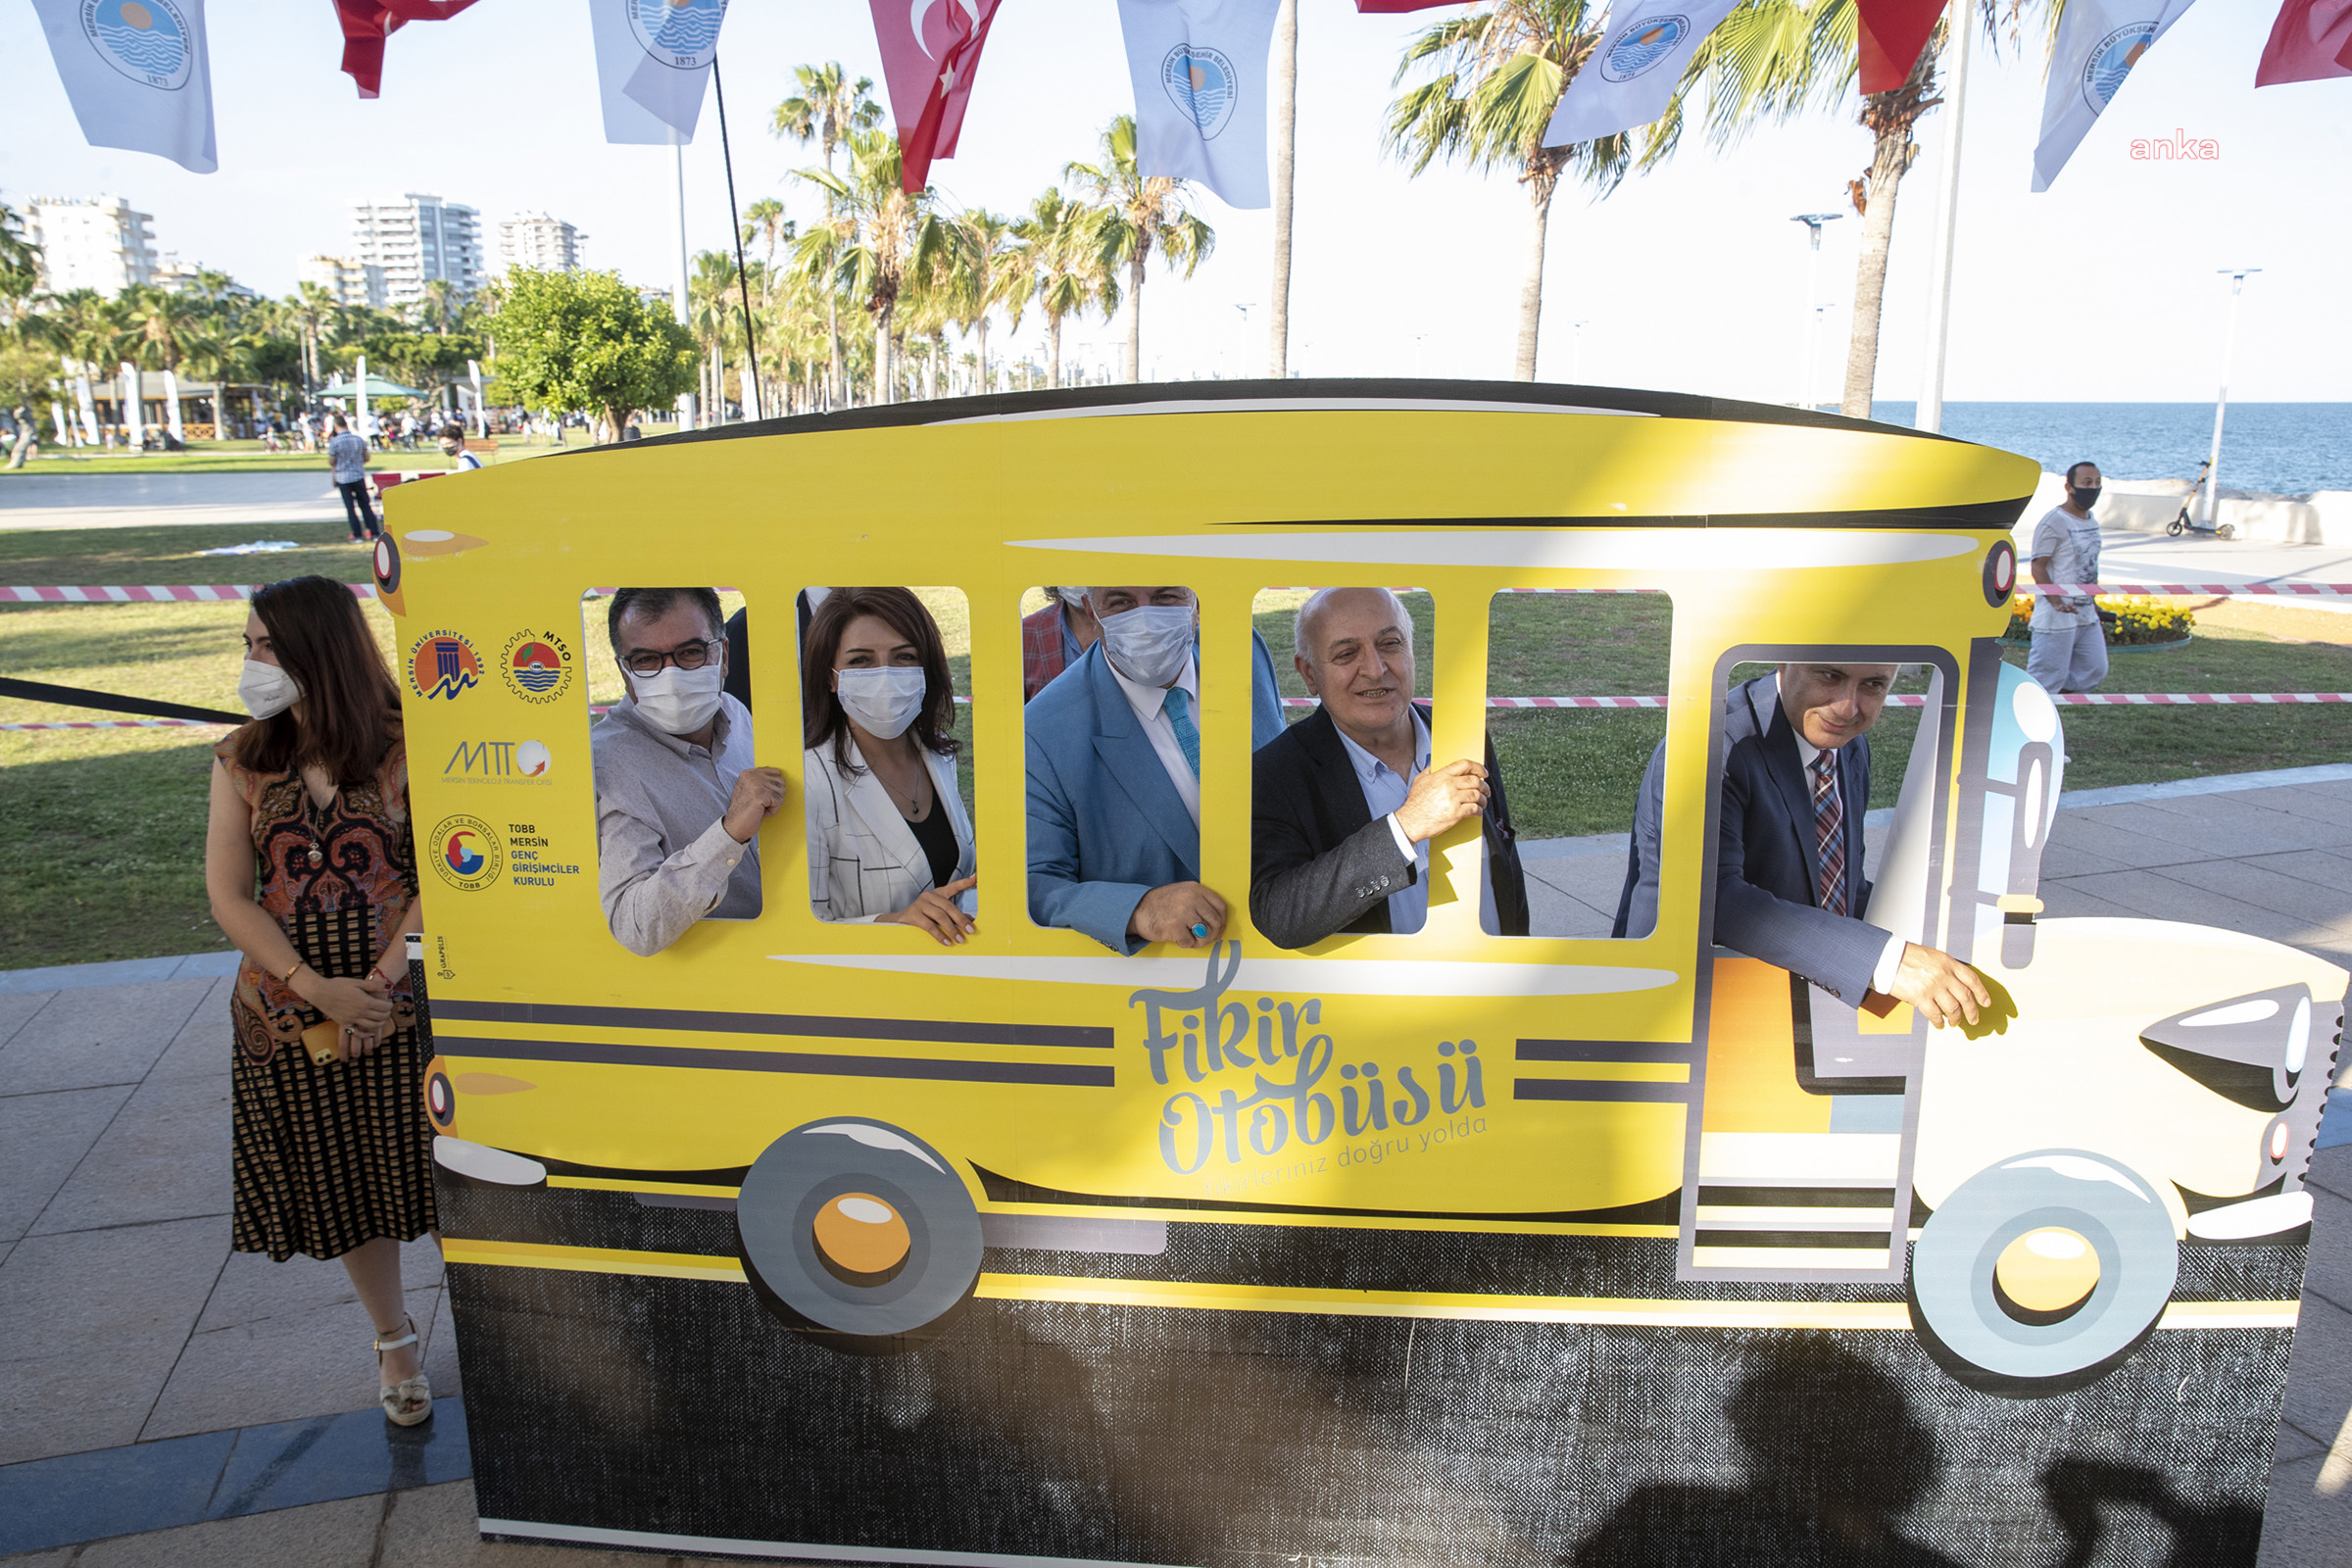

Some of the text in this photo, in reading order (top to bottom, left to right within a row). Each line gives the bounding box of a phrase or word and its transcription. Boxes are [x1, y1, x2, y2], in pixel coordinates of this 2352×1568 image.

[674, 56, 697, 67] 1873
[1165, 57, 1176, 84] MERSİN
[2086, 49, 2104, 82] MERSİN
[146, 74, 170, 87] 1873
[542, 630, 572, 662] MTSO
[473, 651, 486, 675] 1992
[432, 820, 453, 847] ODALAR
[466, 818, 499, 852] BORSALAR
[508, 823, 536, 834] TOBB
[510, 835, 549, 848] MERSİN
[511, 850, 539, 861] GENÇ
[512, 861, 580, 874] GİRİŞİMCİLER
[514, 876, 556, 887] KURULU
[1128, 939, 1323, 1086] Fikir
[1158, 1033, 1487, 1176] Otobüsü
[1204, 1116, 1488, 1198] fikirleriniz doğru yolda
